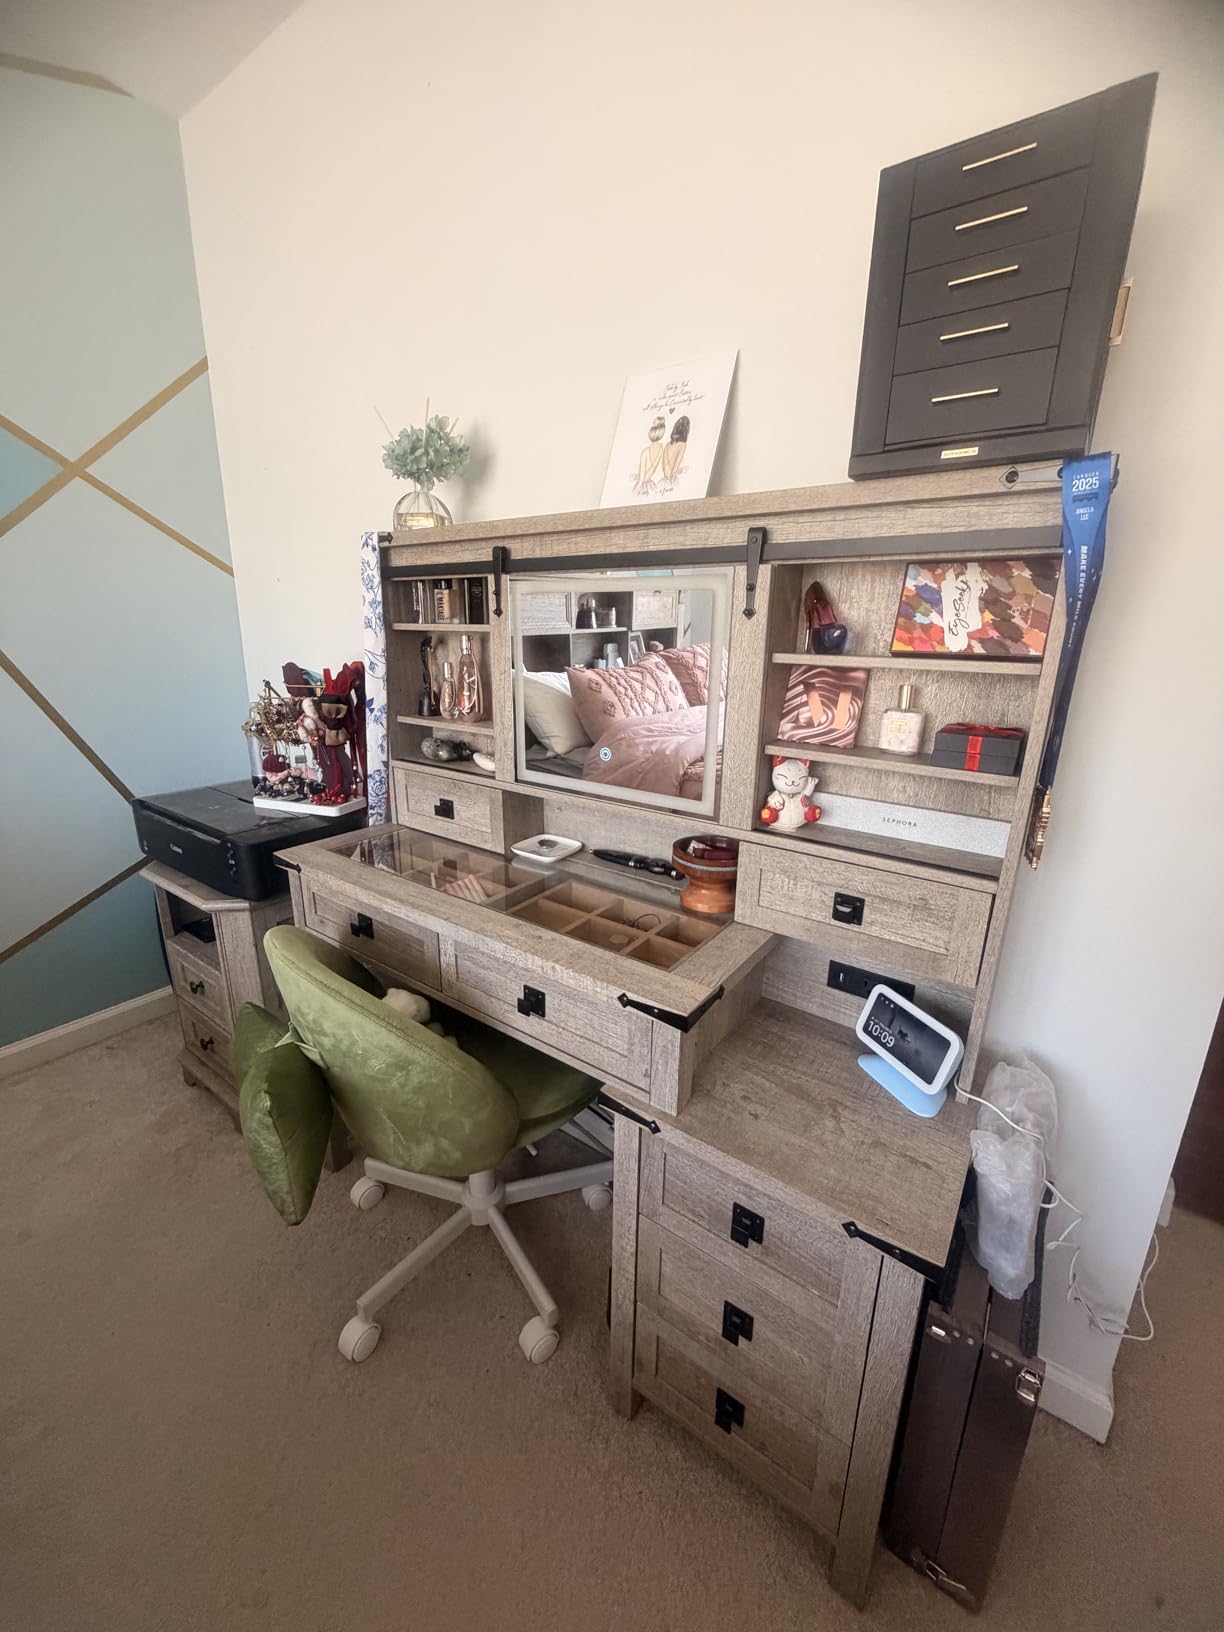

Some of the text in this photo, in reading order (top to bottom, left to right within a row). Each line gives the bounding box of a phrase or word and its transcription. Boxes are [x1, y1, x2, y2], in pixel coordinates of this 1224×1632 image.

[1072, 476, 1099, 492] 2025
[1080, 545, 1088, 570] MAKE
[1078, 572, 1086, 598] EVERY
[881, 816, 918, 828] SEPHORA
[867, 1020, 895, 1048] 10:09
